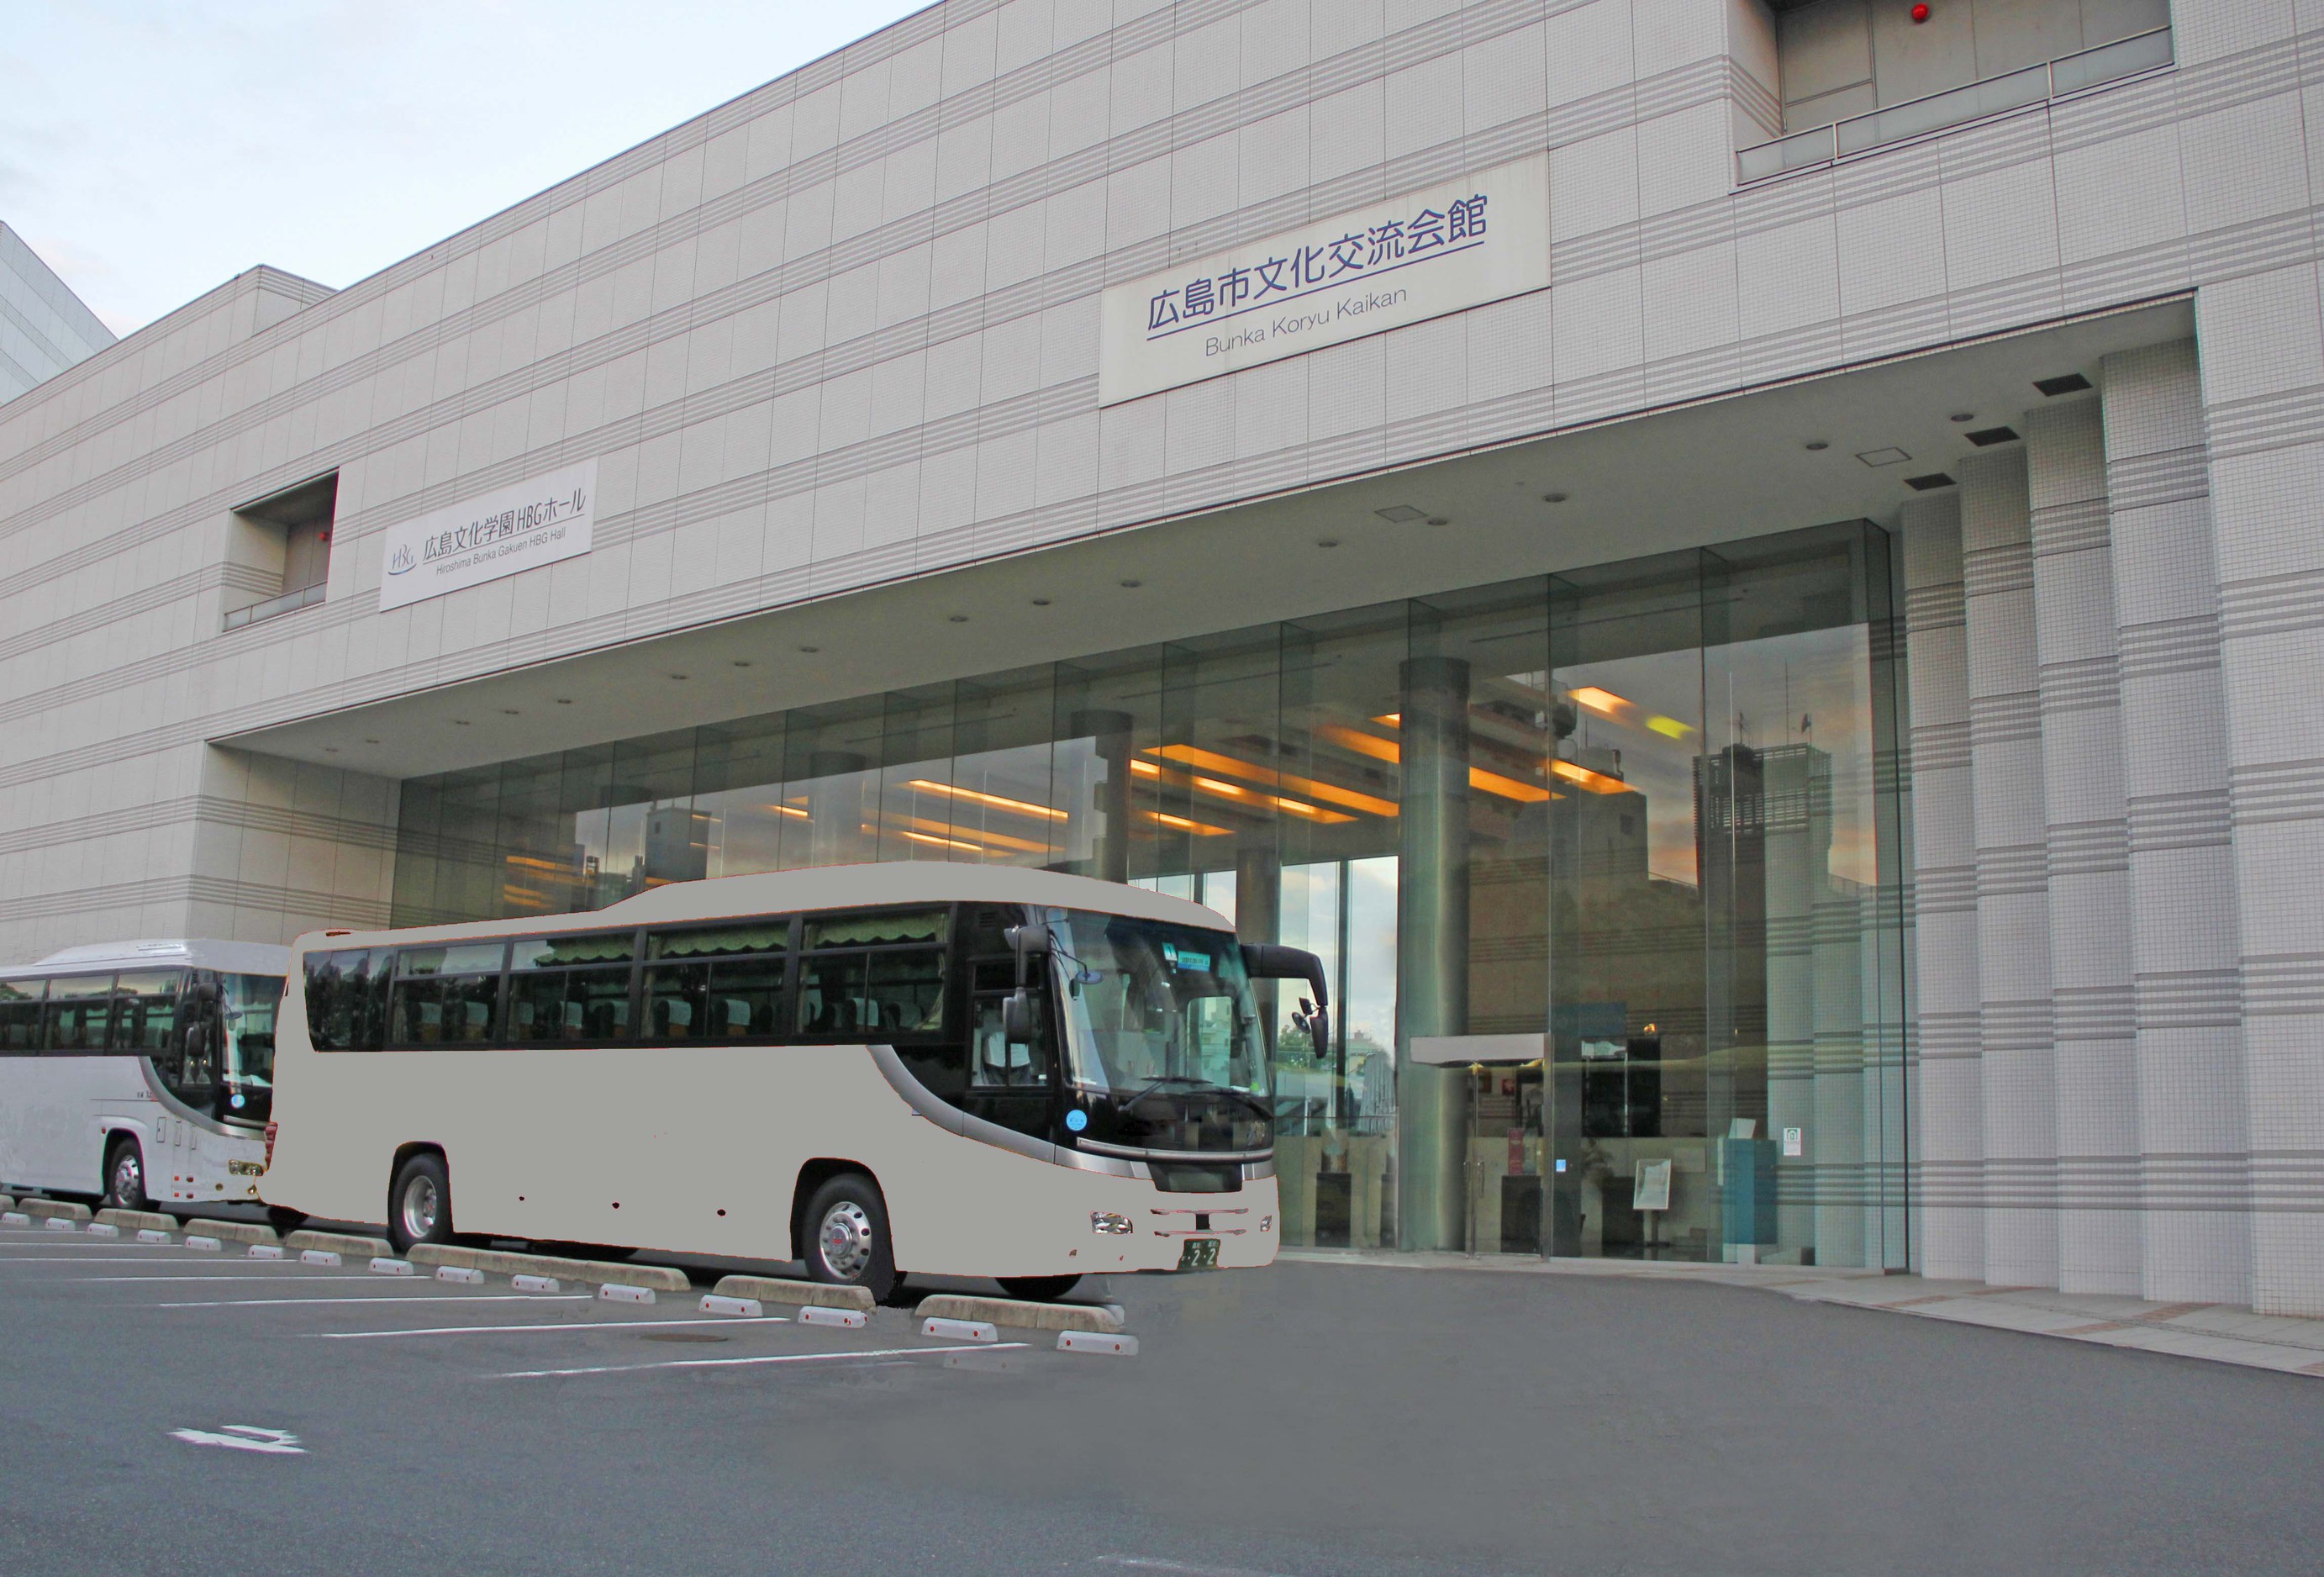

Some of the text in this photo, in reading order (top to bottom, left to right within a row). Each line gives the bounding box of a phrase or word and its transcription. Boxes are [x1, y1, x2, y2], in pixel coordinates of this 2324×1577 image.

[1147, 193, 1488, 330] 広島市文化交流会館
[1205, 288, 1407, 356] Bunka Koryu Kaikan
[436, 526, 567, 576] Hiroshima Bunka Gakuen HBG Hall
